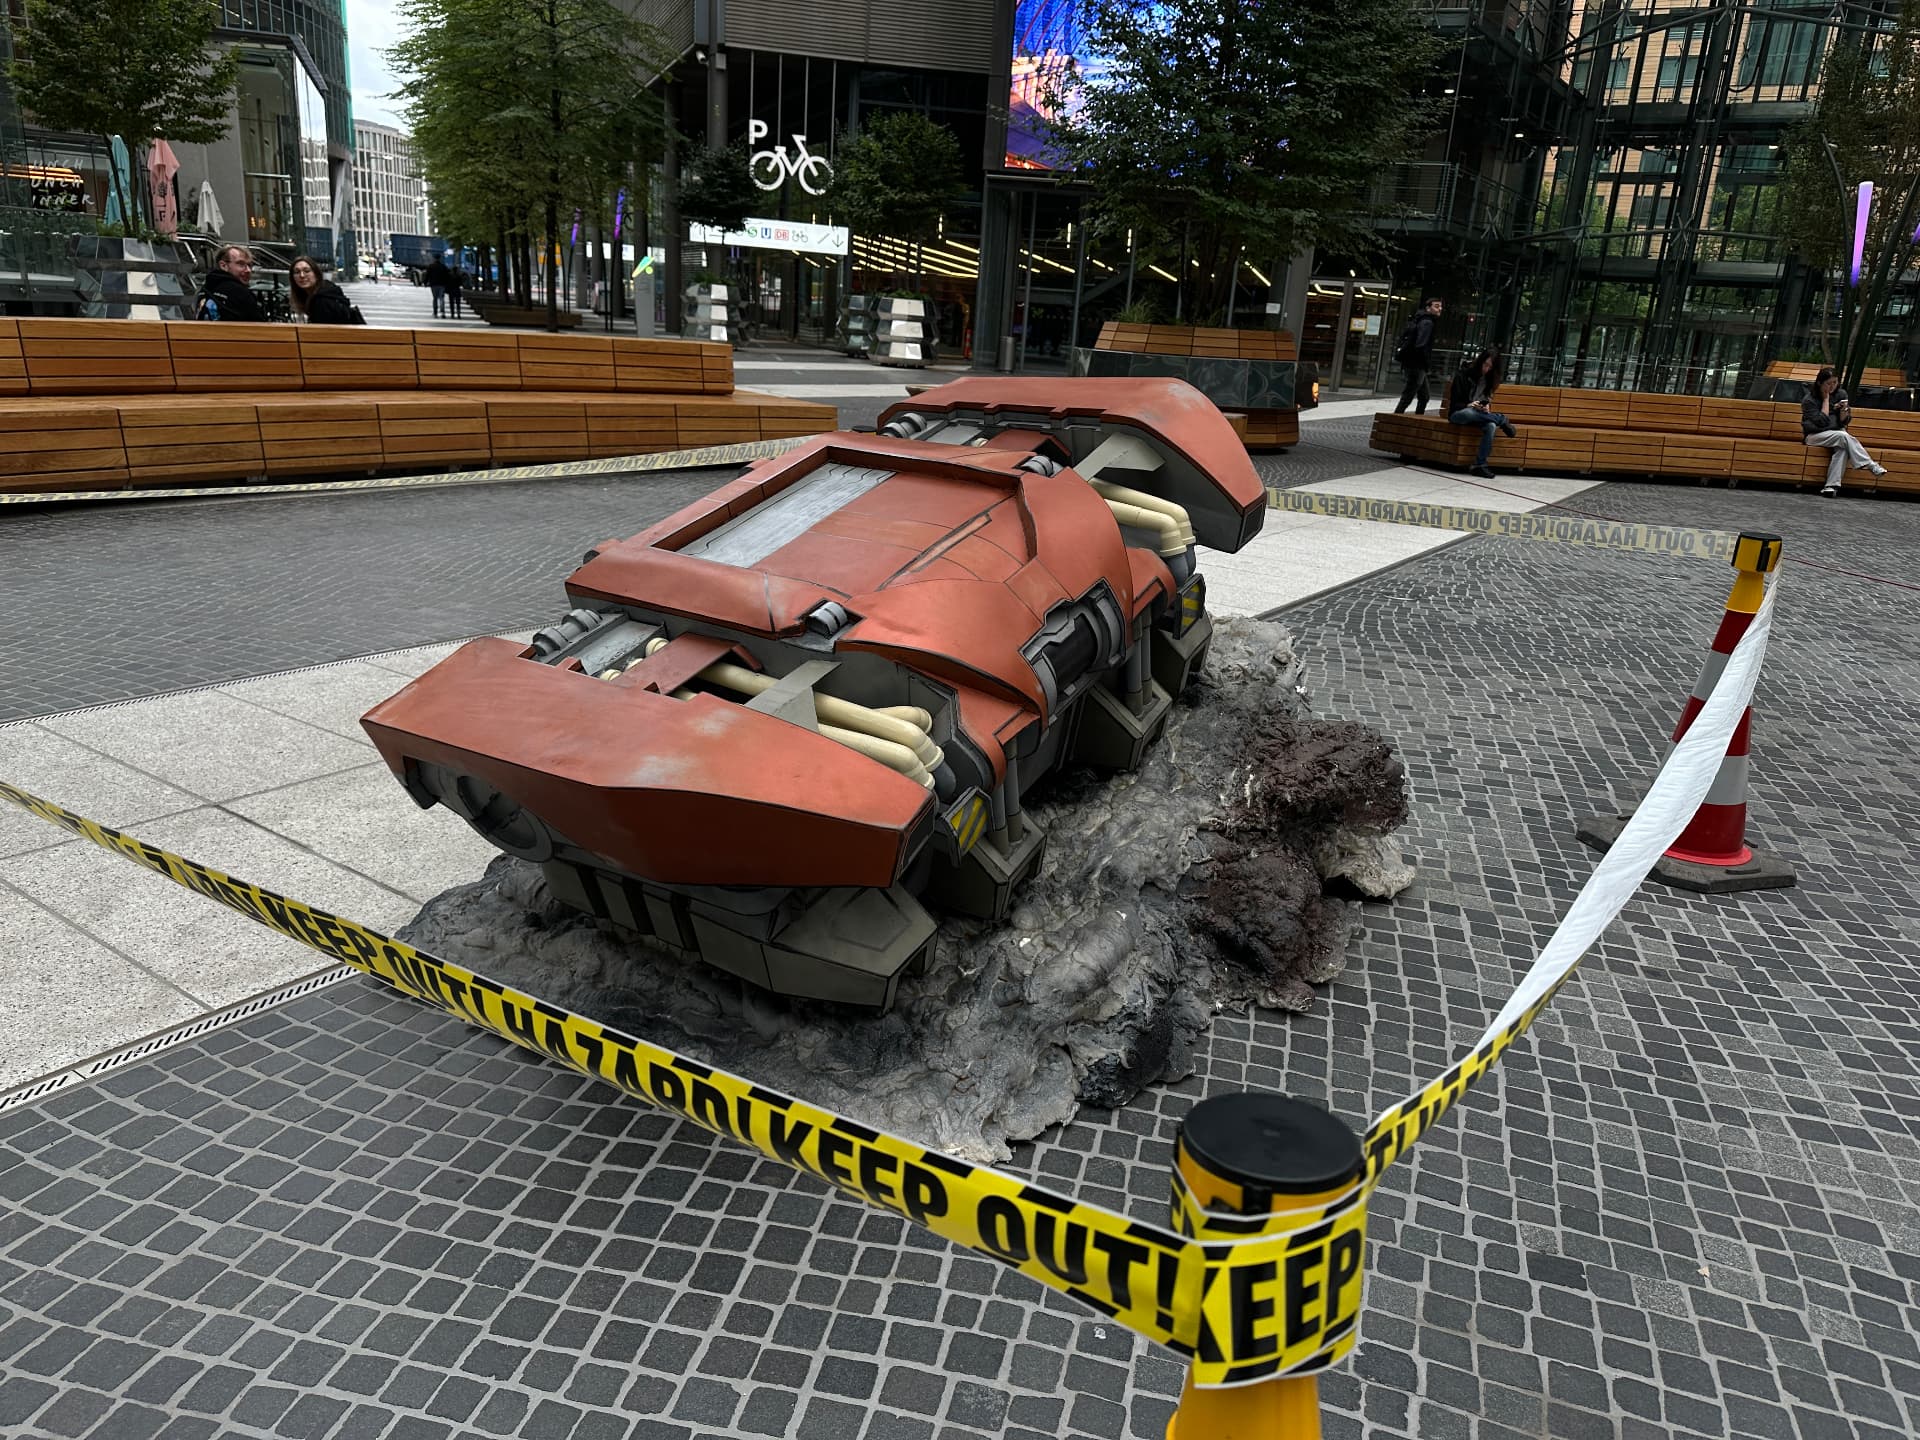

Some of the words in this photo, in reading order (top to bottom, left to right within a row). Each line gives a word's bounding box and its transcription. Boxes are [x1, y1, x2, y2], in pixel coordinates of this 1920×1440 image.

[749, 119, 768, 145] P
[32, 194, 95, 207] INNER
[761, 227, 771, 239] U
[769, 1108, 949, 1226] KEEP
[976, 1194, 1180, 1334] OUT!
[1196, 1228, 1362, 1364] KEEP
